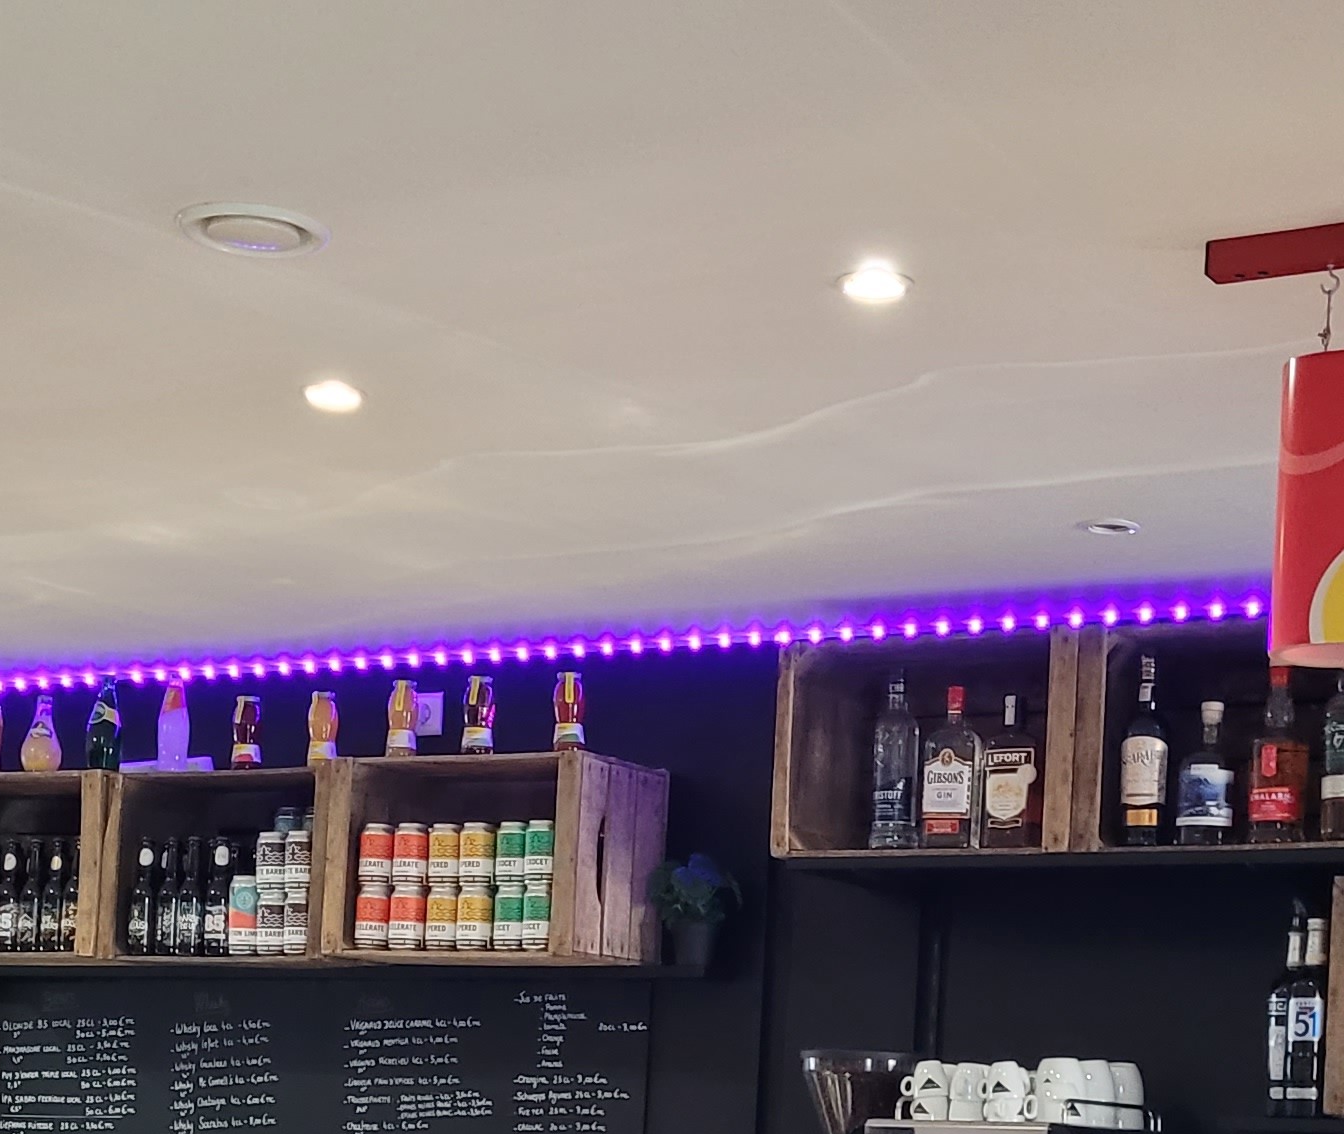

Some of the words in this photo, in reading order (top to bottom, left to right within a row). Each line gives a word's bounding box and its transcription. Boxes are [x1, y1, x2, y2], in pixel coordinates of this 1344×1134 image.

[988, 753, 1027, 765] LEFORT
[927, 770, 964, 784] GIBSON'S
[937, 791, 952, 799] GIN
[1294, 1011, 1317, 1037] 51
